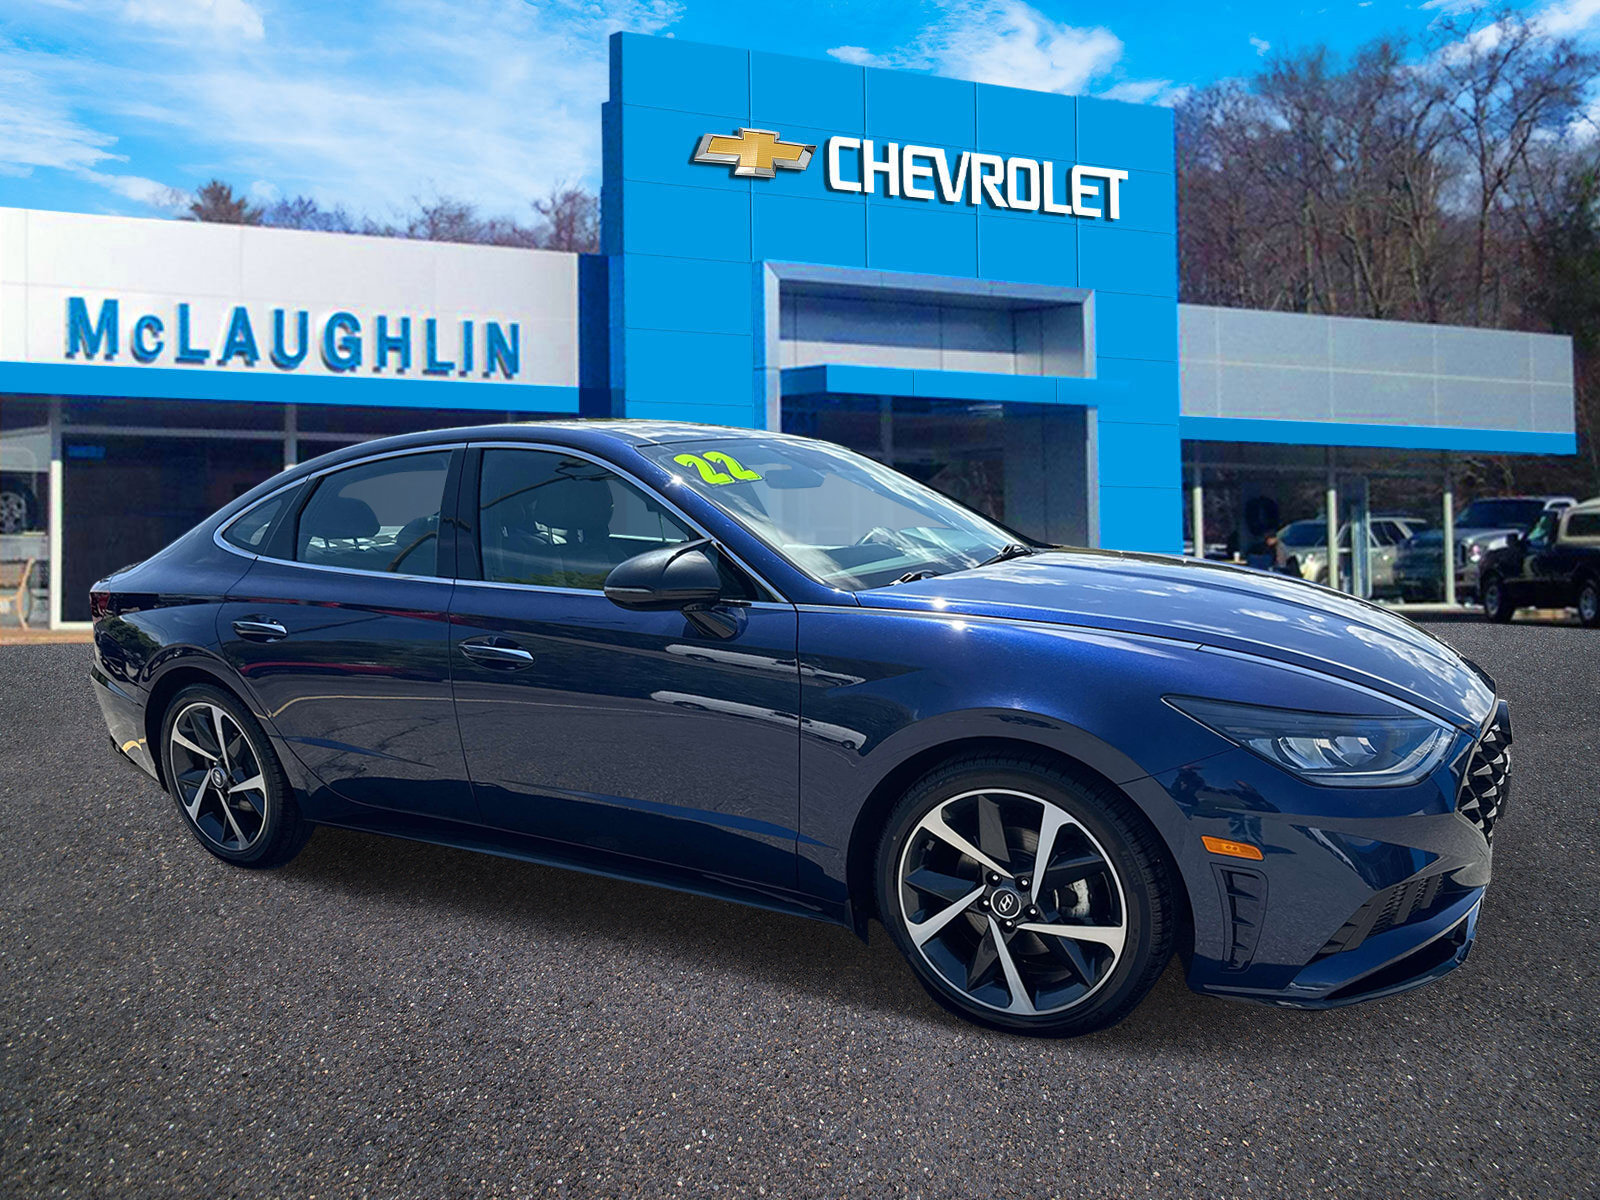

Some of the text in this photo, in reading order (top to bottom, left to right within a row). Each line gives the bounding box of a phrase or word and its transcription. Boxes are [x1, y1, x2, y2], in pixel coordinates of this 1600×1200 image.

[828, 135, 1128, 219] CHEVROLET
[66, 296, 520, 378] McLAUGHLIN
[673, 451, 763, 486] 22
